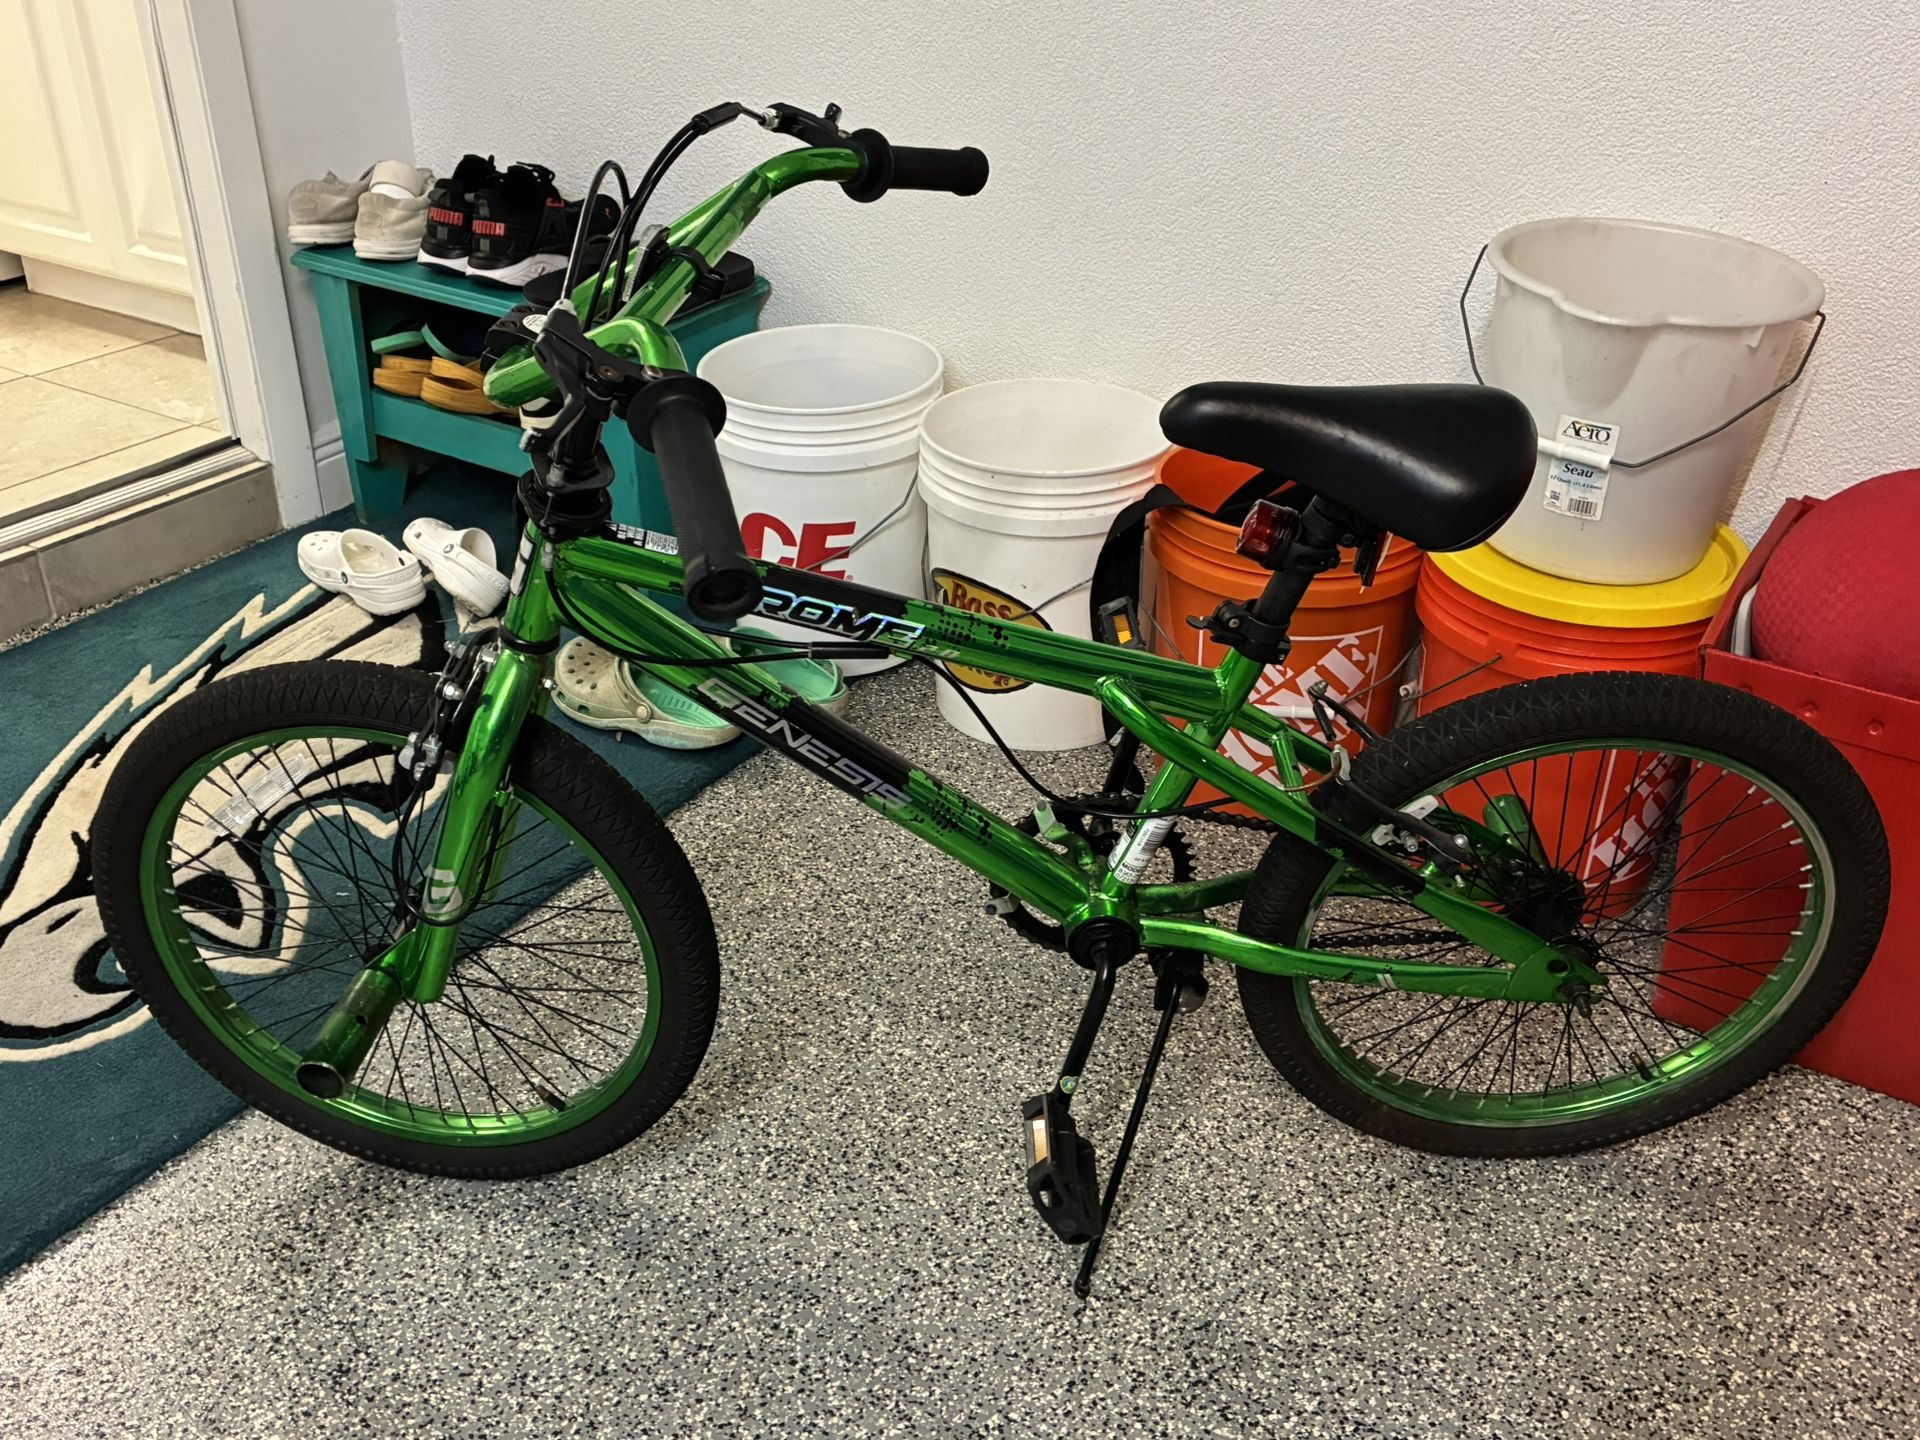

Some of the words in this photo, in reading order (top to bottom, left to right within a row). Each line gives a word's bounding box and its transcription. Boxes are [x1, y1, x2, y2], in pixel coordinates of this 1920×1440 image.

[428, 206, 464, 227] PUMA
[1562, 420, 1612, 443] Aero
[1562, 463, 1594, 479] Seau
[741, 512, 857, 580] CE
[753, 585, 926, 650] ROME
[697, 677, 913, 808] GENESIS
